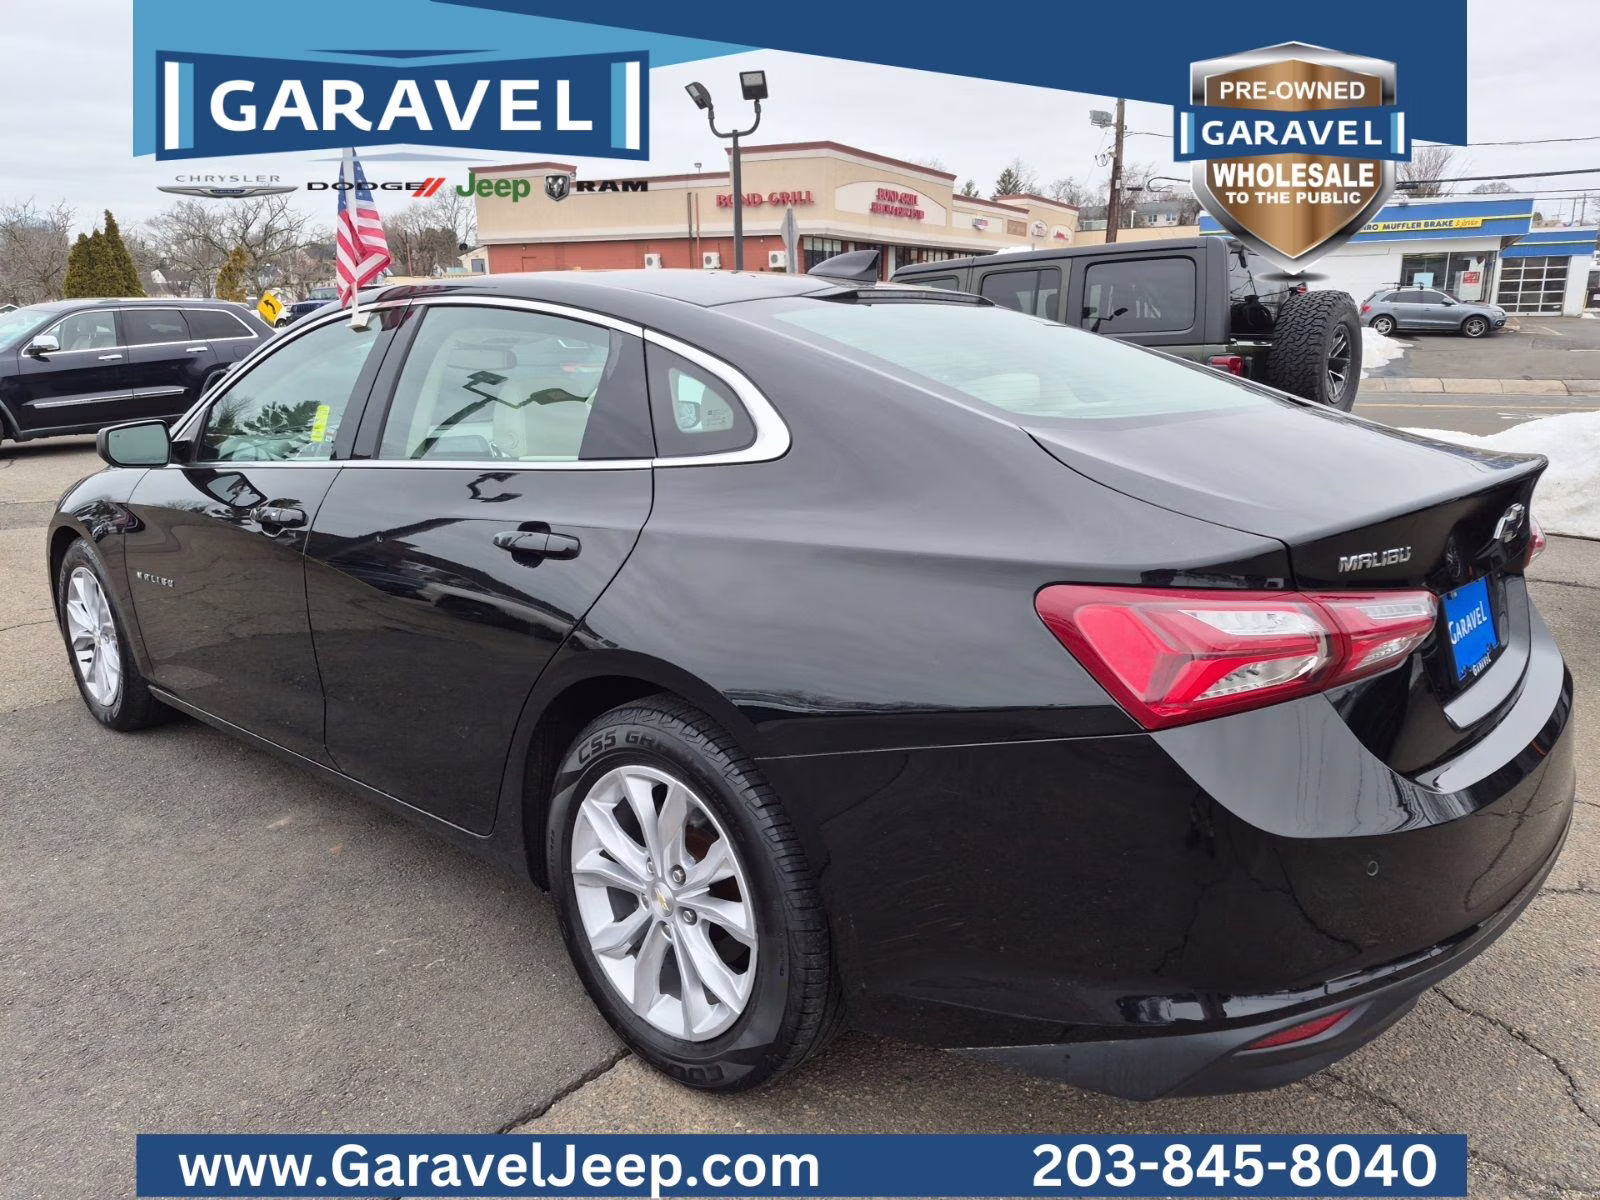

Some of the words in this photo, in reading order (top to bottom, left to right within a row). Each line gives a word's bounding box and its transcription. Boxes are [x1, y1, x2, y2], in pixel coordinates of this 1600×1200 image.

[767, 190, 815, 208] GRILL
[1382, 221, 1422, 231] MUFFLER
[1423, 219, 1454, 229] BRAKE
[1338, 546, 1412, 574] MALIBU
